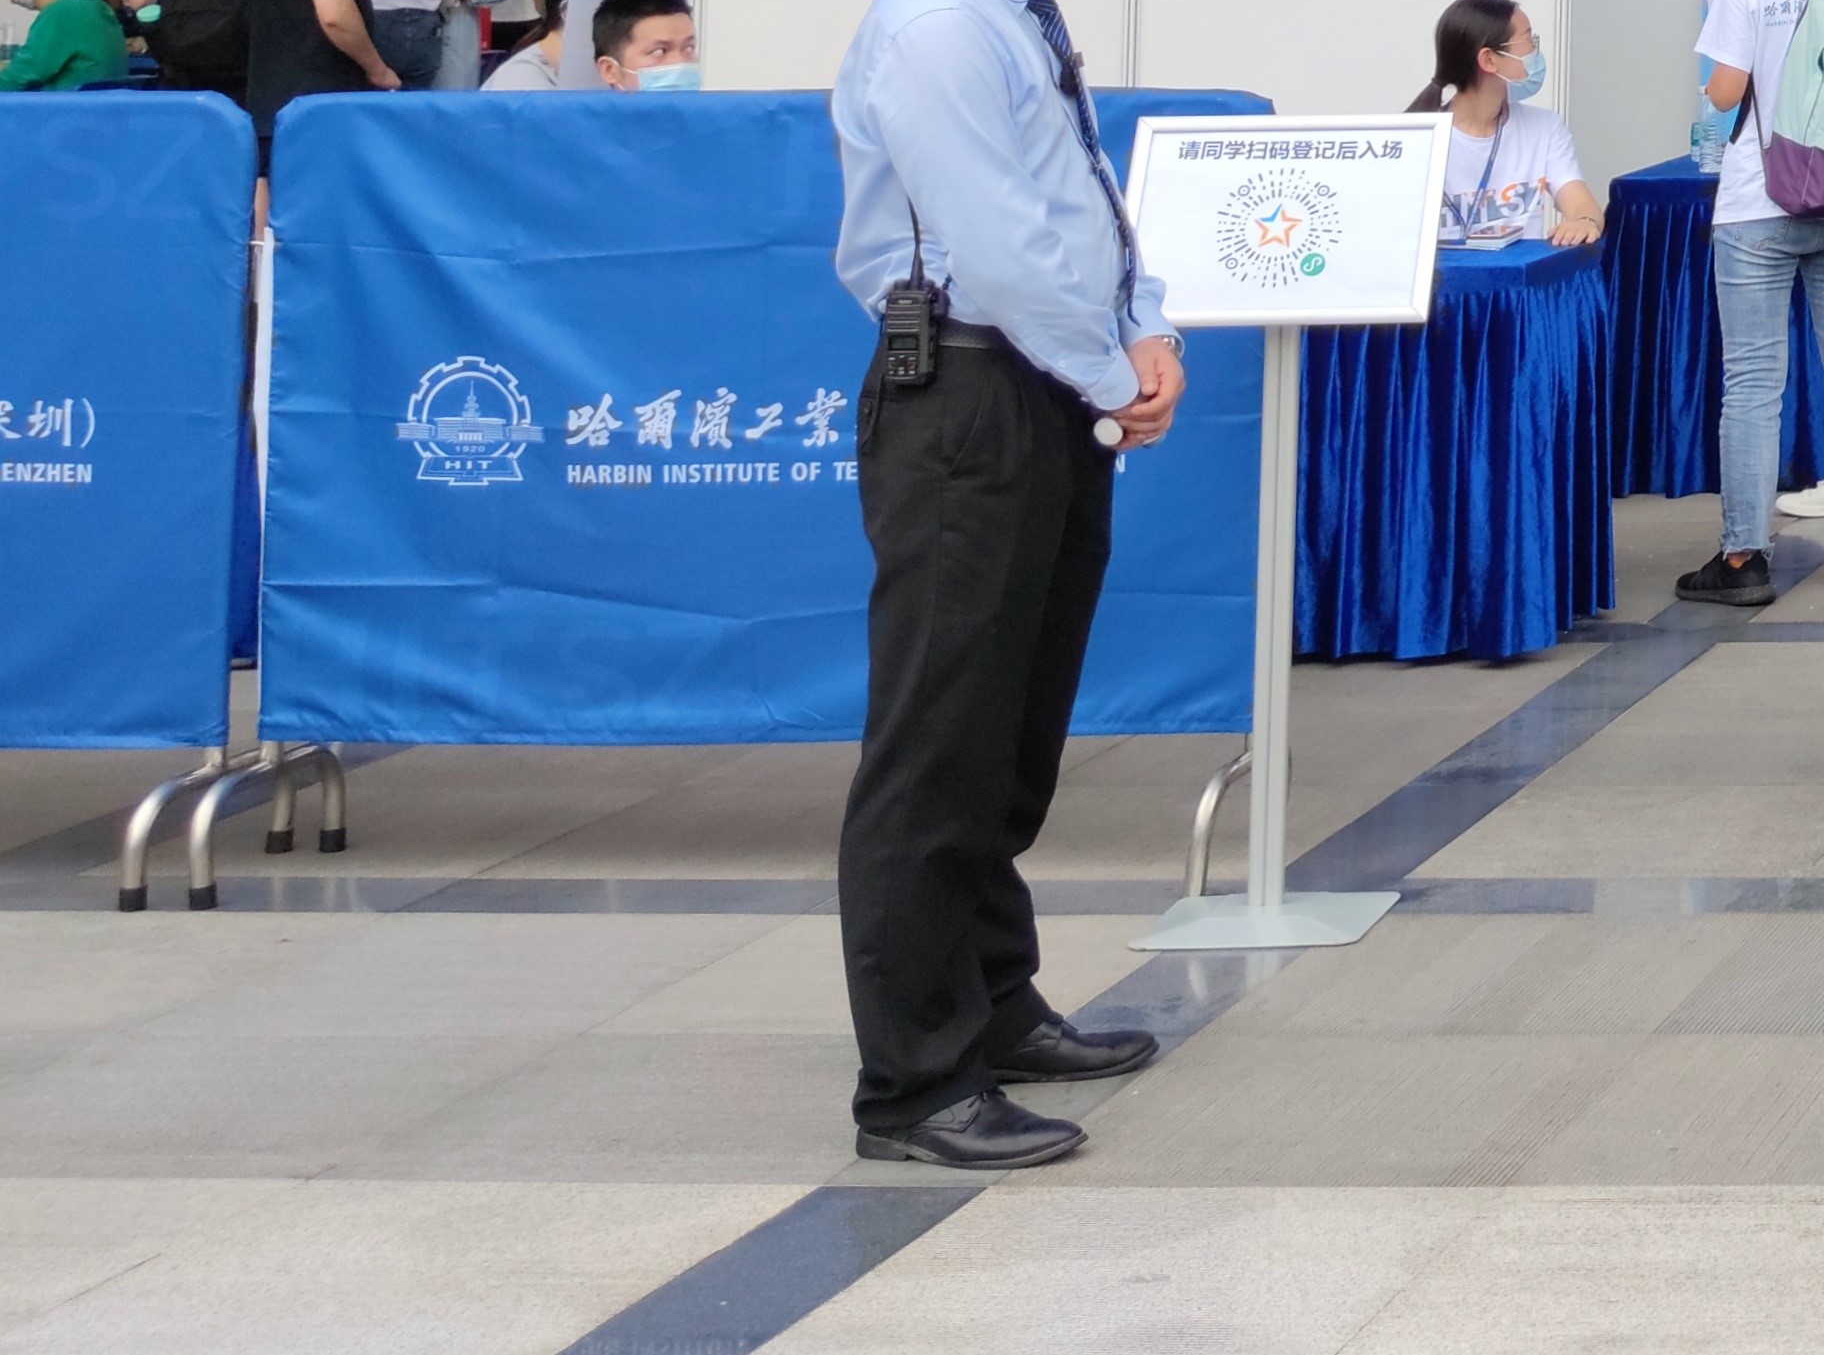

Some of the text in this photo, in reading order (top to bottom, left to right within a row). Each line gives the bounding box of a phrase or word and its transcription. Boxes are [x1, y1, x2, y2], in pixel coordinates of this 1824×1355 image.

[1177, 140, 1403, 160] 请同学扫码登记后入场
[564, 387, 848, 450] 哈爾濱工業
[454, 444, 486, 454] 1920
[444, 458, 494, 471] HIT
[567, 462, 653, 485] HARBIN
[663, 461, 781, 484] INSTITUTE
[791, 461, 822, 483] OF
